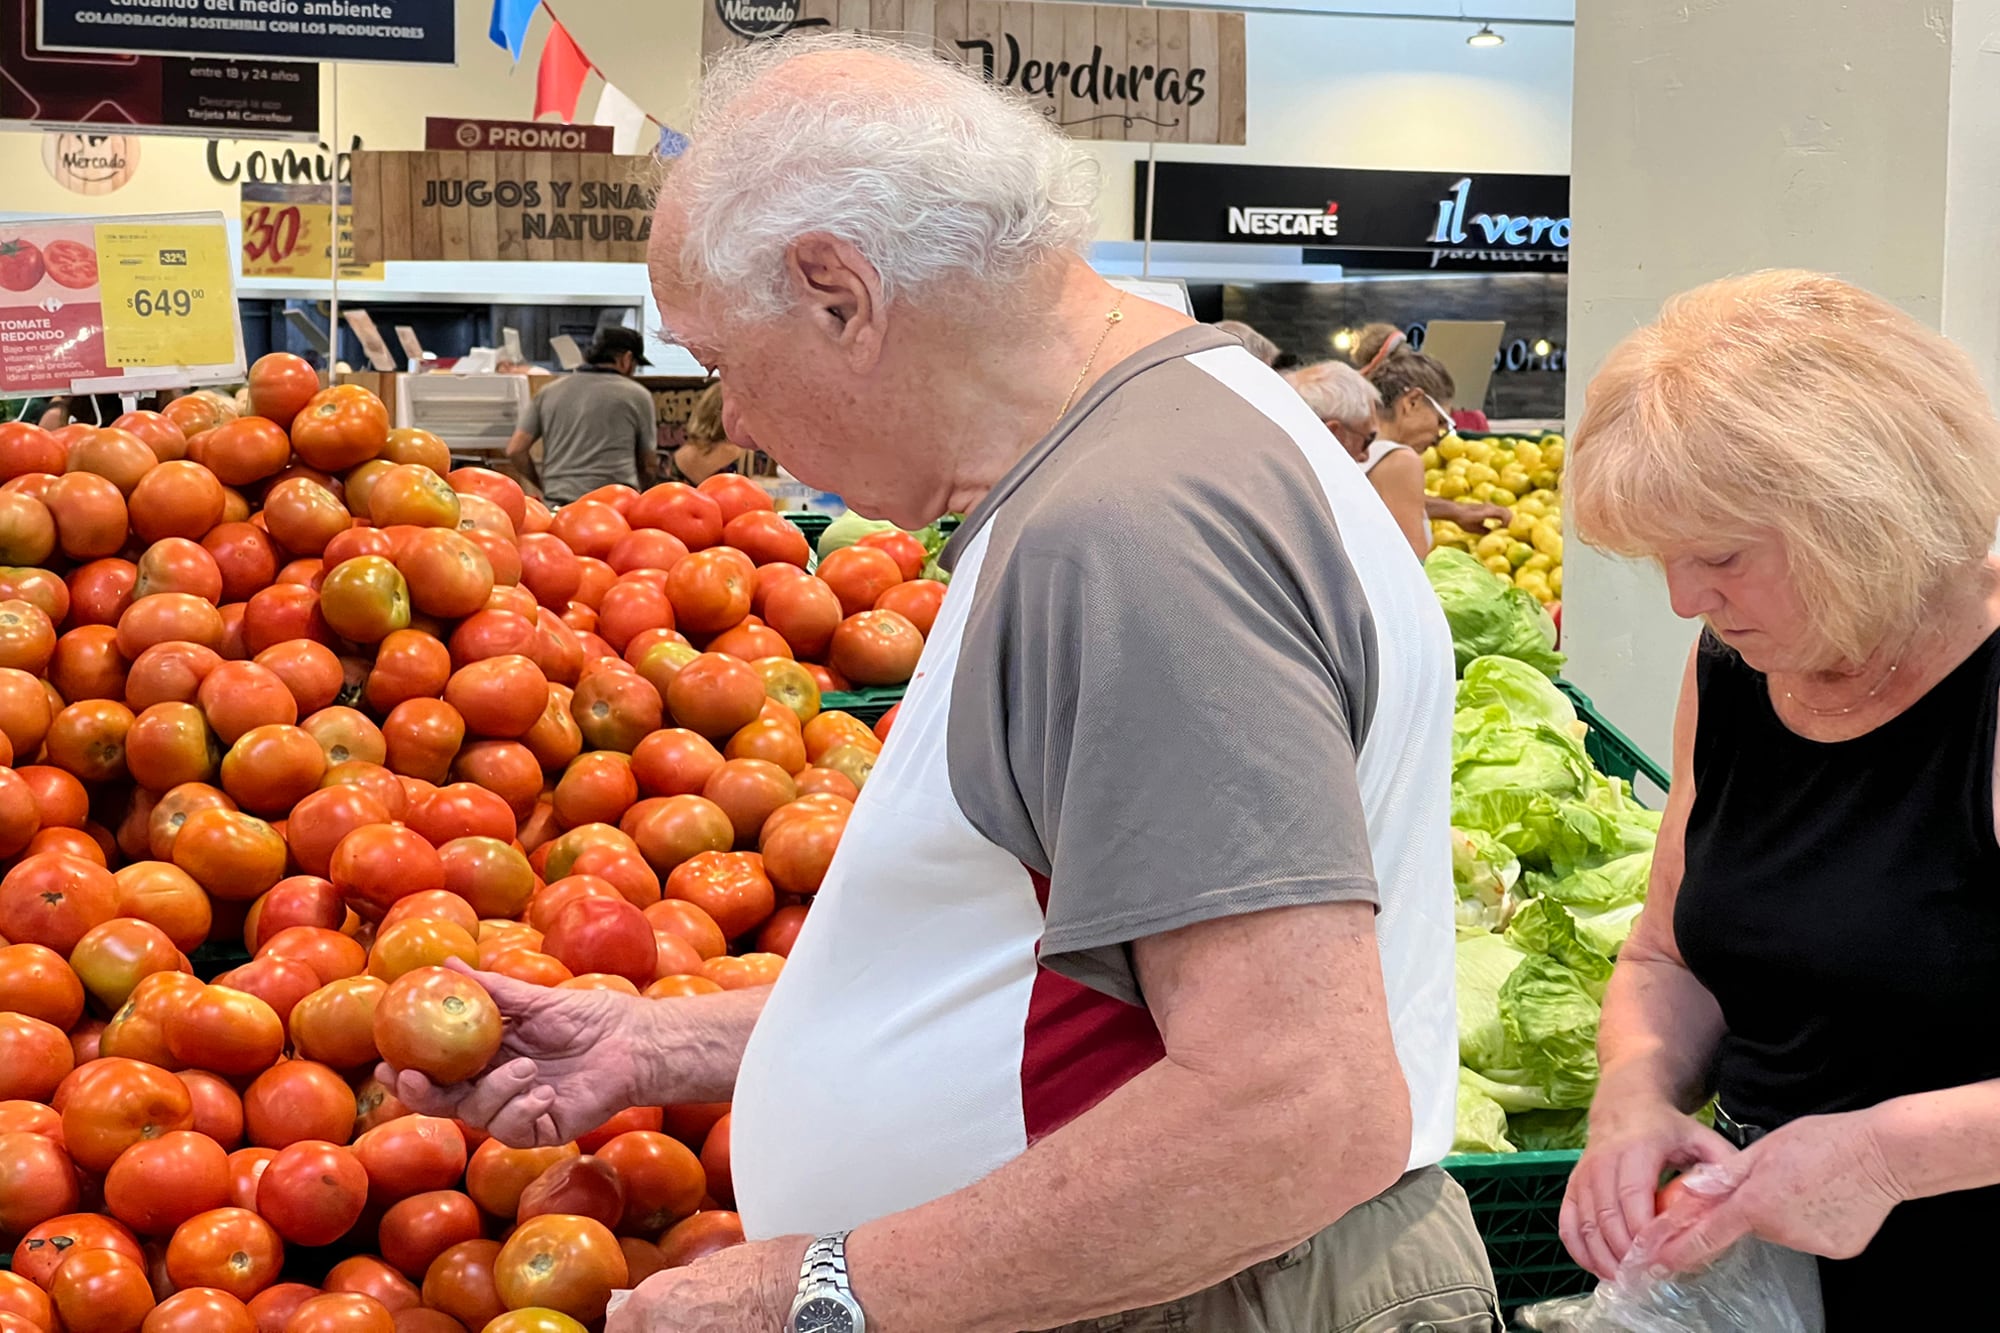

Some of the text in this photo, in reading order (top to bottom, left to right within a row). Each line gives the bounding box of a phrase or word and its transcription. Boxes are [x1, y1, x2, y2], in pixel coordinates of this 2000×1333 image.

[204, 0, 234, 11] del
[239, 0, 299, 14] medio
[303, 1, 392, 18] ambiente
[724, 0, 795, 21] Mercado
[75, 11, 424, 39] COLABORACIÓN SOSTENIBLE CON LOS PRODUCTORES
[190, 67, 300, 82] entre 18 y 24 años
[954, 32, 1206, 106] Verduras
[187, 108, 293, 123] Tarjeta Mi Carrefour
[489, 128, 586, 149] PROMO!
[63, 152, 126, 169] Mercado
[423, 180, 541, 208] JUGOS
[549, 181, 572, 208] Y
[243, 206, 300, 263] 30
[161, 253, 186, 263] -32%
[0, 319, 51, 330] TOMATE
[0, 330, 65, 342] REDONDO
